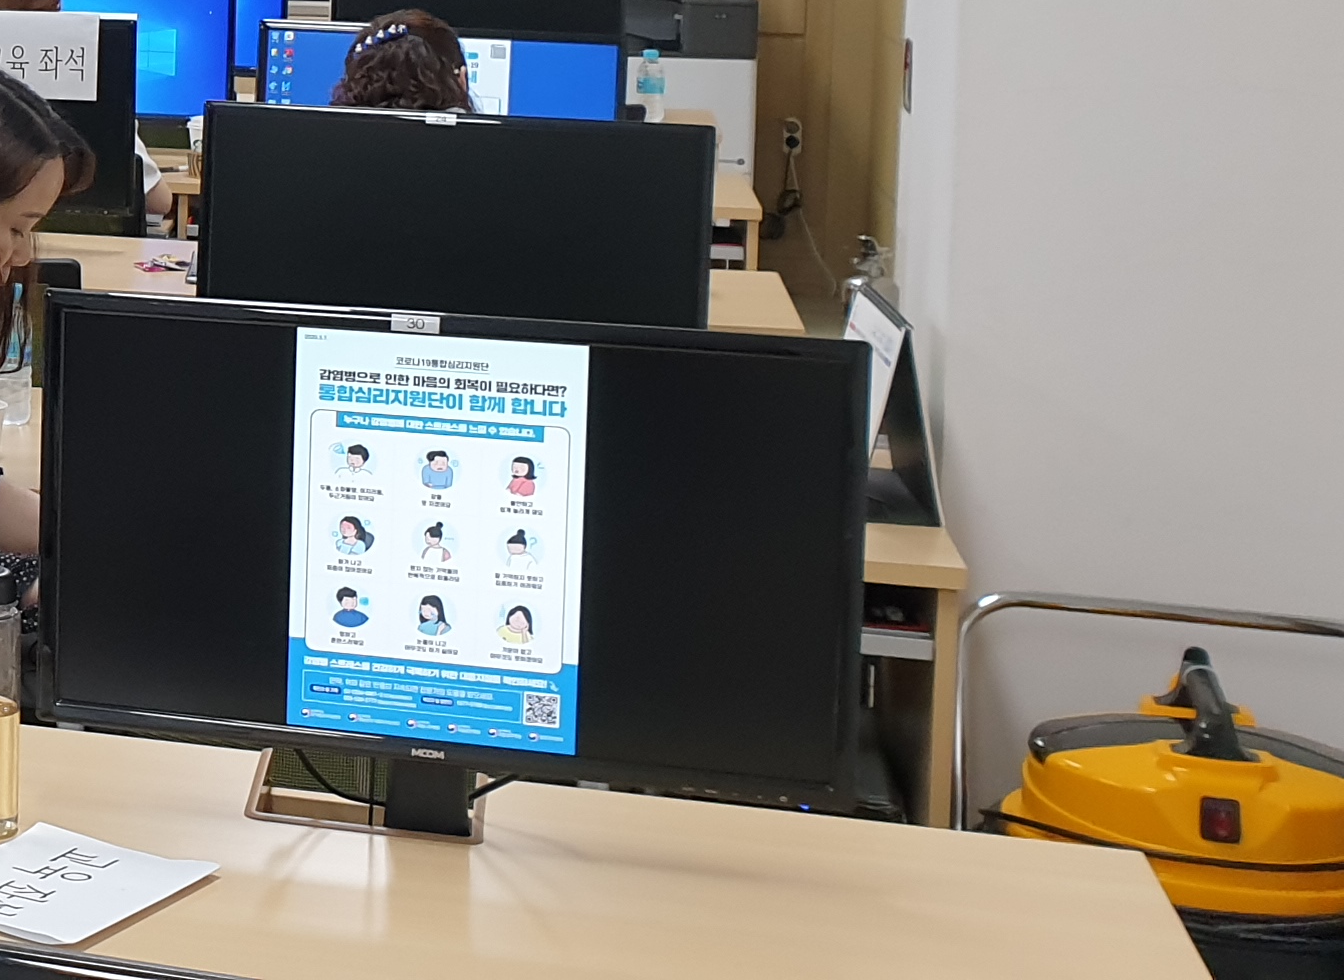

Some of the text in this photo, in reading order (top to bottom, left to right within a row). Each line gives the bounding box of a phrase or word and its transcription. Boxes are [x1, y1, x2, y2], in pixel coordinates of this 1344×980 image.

[38, 45, 87, 82] 좌석
[406, 318, 425, 330] 30
[319, 368, 567, 397] 감염병으로 인한 마음의 회복이 필요하다면?
[319, 383, 567, 418] 통합심리지원단이 함께 합니다
